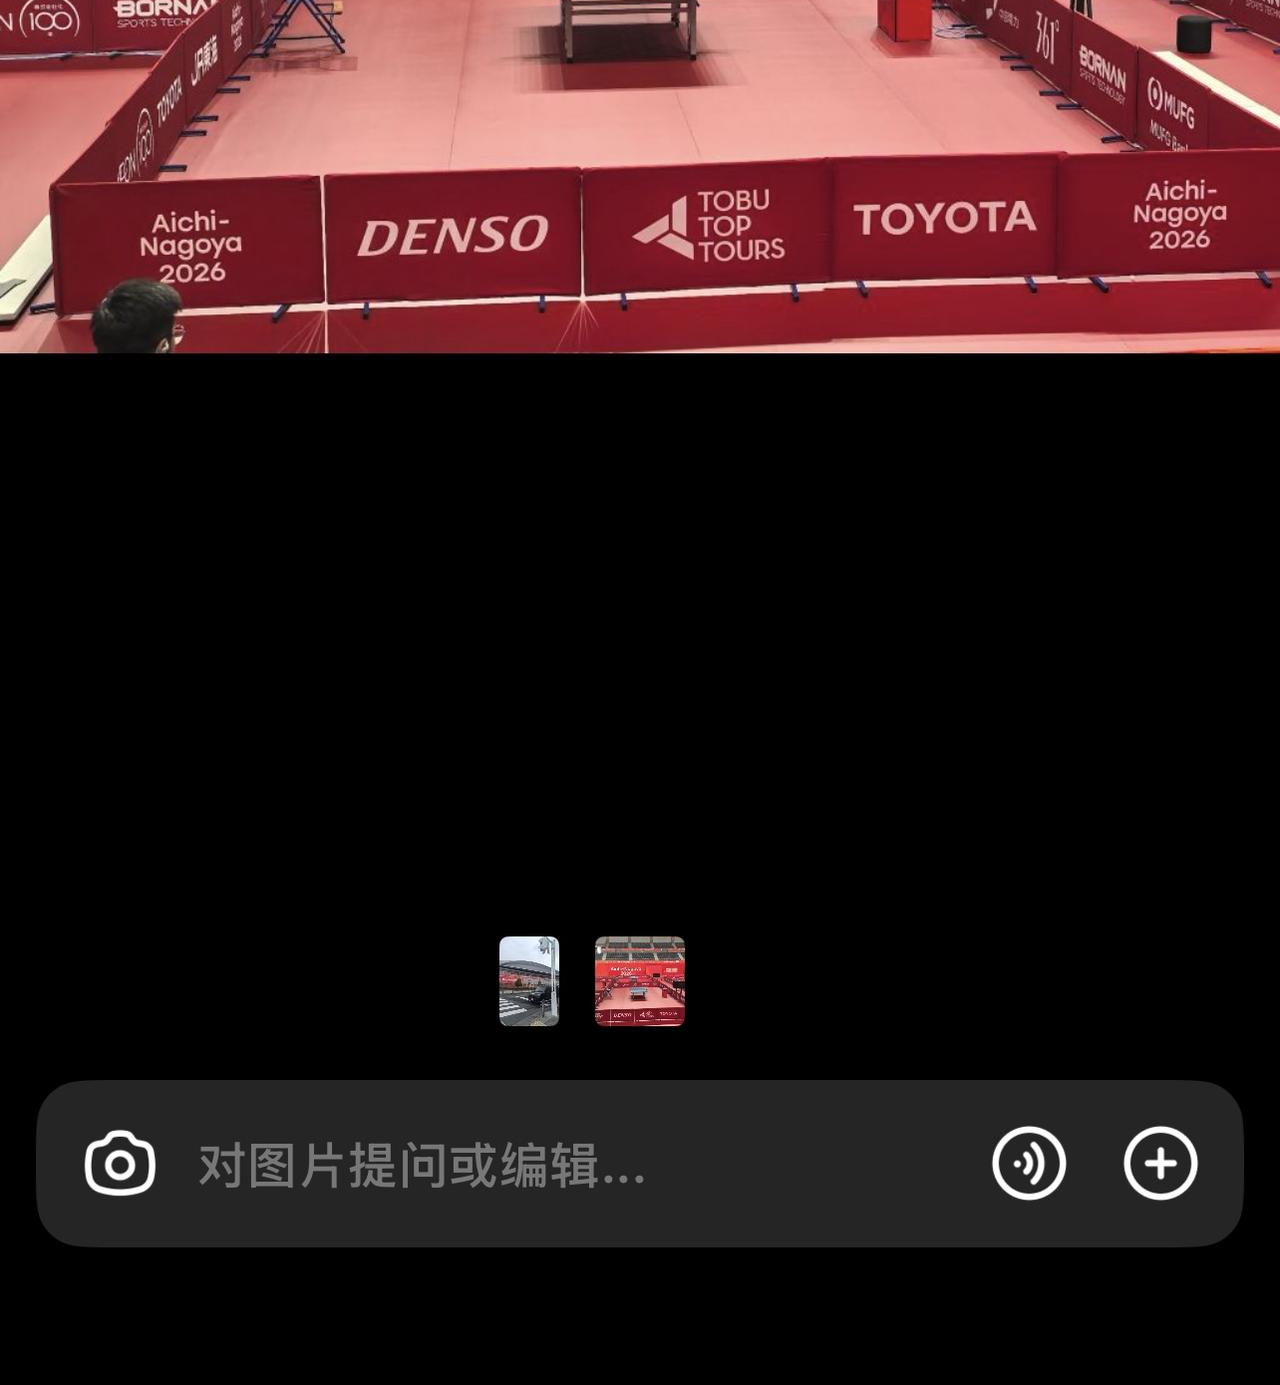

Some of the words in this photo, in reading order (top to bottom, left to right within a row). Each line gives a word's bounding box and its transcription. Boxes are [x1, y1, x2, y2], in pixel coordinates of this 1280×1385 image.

[29, 11, 72, 31] 100
[115, 17, 158, 29] SPORTS
[1079, 44, 1126, 93] BORNAN
[157, 75, 182, 127] TOYOTA
[1163, 91, 1195, 130] MUFG
[1150, 119, 1171, 146] MUFG
[698, 189, 769, 212] TOBU
[1145, 179, 1217, 201] Aichi-
[152, 209, 229, 233] Aichi-
[698, 215, 752, 236] TOP
[854, 201, 1036, 235] TOYOTA
[1134, 205, 1226, 227] Nagoya
[358, 215, 548, 256] DENSO
[1150, 230, 1210, 249] 2026
[141, 237, 242, 260] Nagoya
[698, 238, 786, 263] TOURS
[159, 262, 228, 284] 2026
